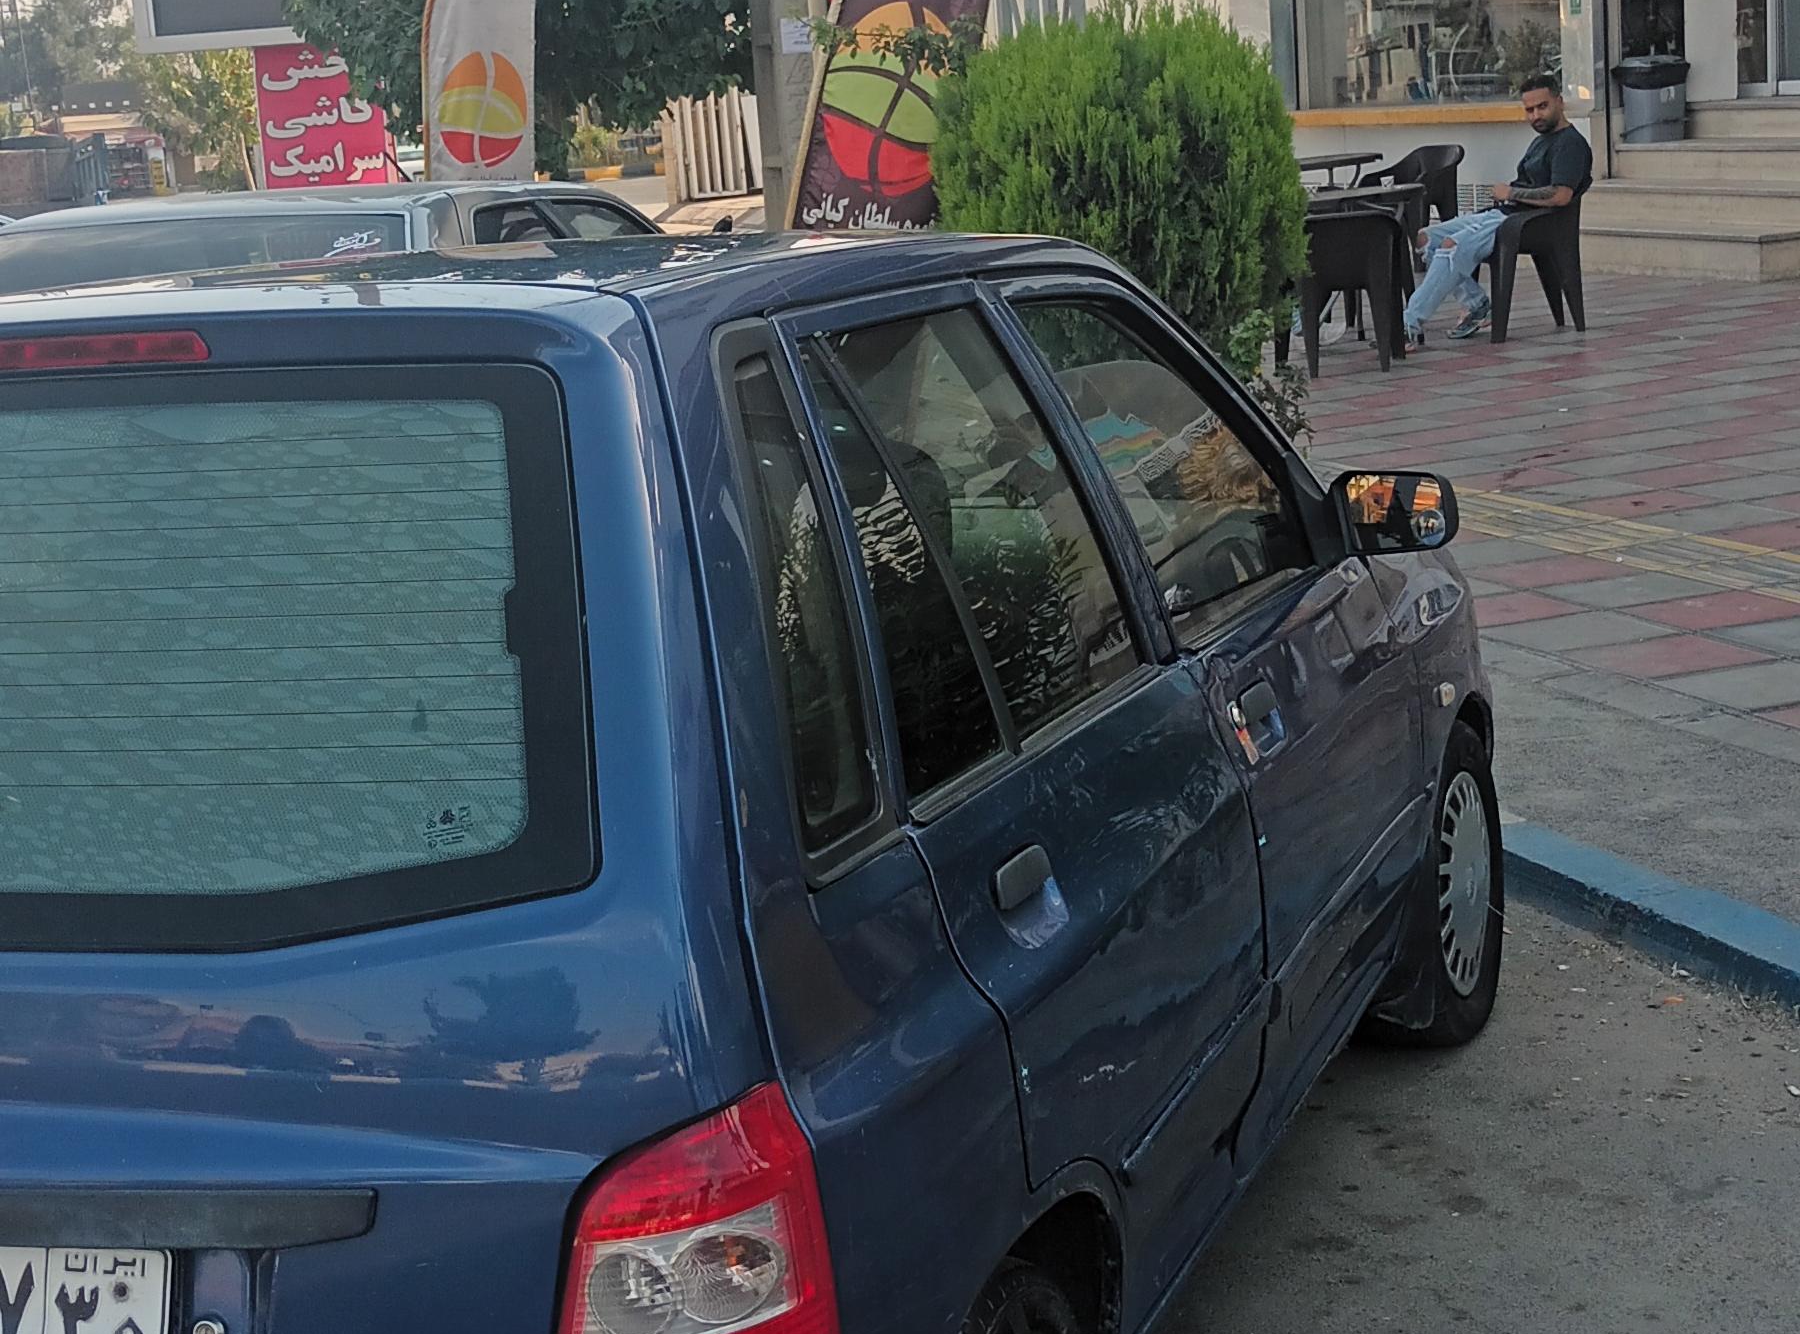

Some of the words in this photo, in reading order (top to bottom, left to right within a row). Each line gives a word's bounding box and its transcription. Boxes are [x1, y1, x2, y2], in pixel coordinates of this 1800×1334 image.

[262, 46, 349, 91] خش
[802, 193, 850, 229] کیانی
[848, 201, 900, 230] سلطان
[65, 1254, 146, 1278] ایران
